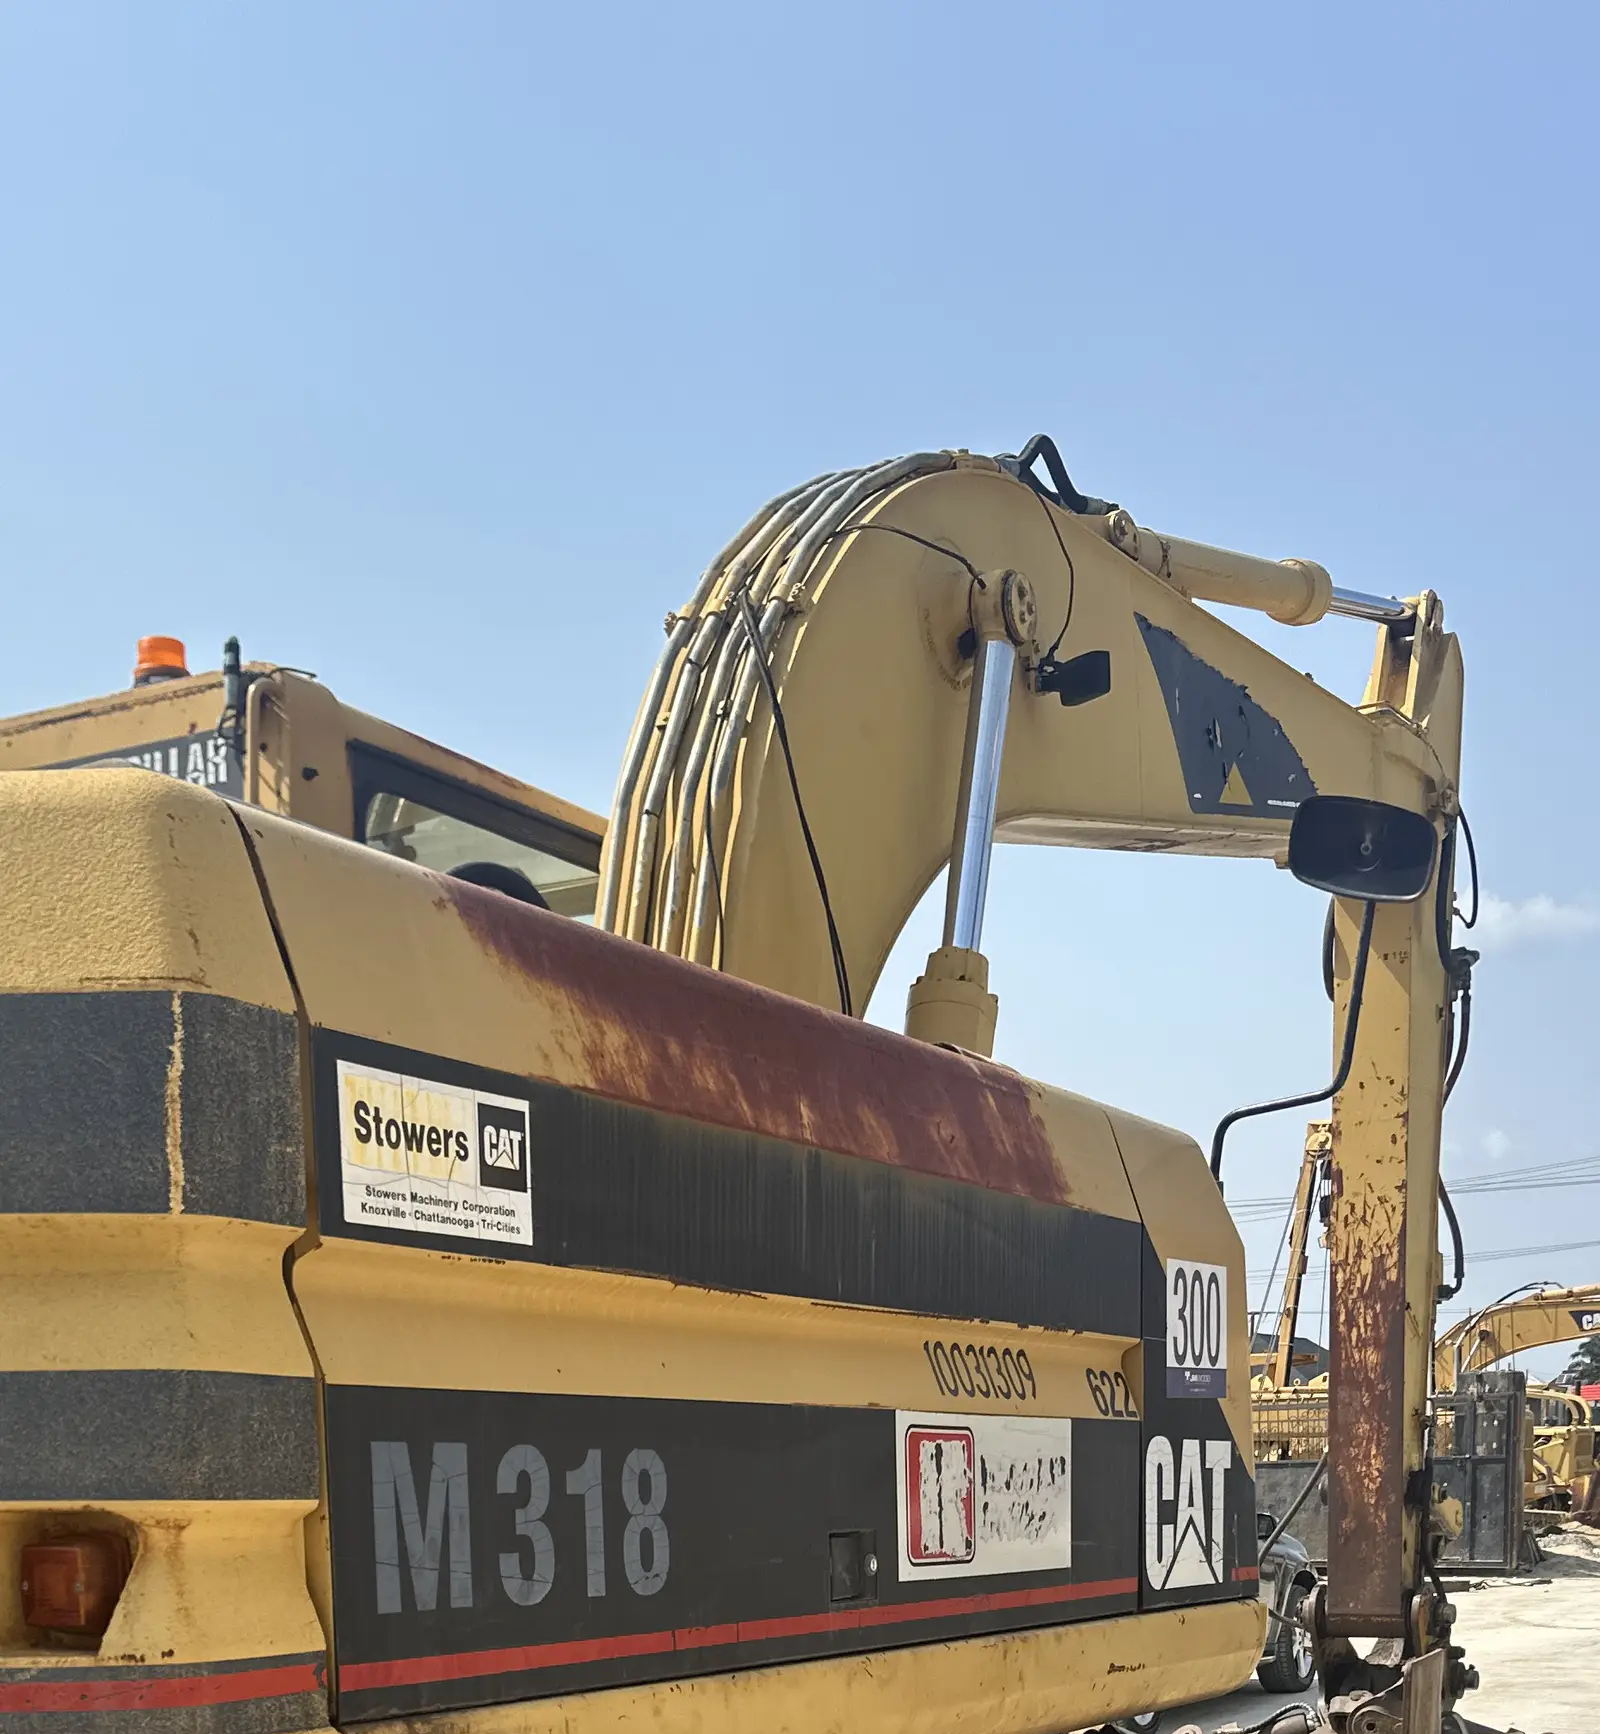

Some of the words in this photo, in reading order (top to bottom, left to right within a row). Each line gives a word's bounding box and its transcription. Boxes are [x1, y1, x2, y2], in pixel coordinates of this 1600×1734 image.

[353, 1100, 469, 1162] Stowers
[484, 1124, 522, 1171] CAT
[361, 1202, 406, 1219] Knoxville
[414, 1210, 475, 1229] Chattanooga
[481, 1219, 521, 1235] Tri-Cities
[365, 1185, 407, 1202] Stowers
[410, 1191, 459, 1211] Machinery
[462, 1200, 516, 1218] Corporation
[1172, 1267, 1221, 1368] 300
[923, 1340, 1037, 1400] 10031309
[1085, 1367, 1138, 1418] 622
[1145, 1435, 1232, 1591] CAT
